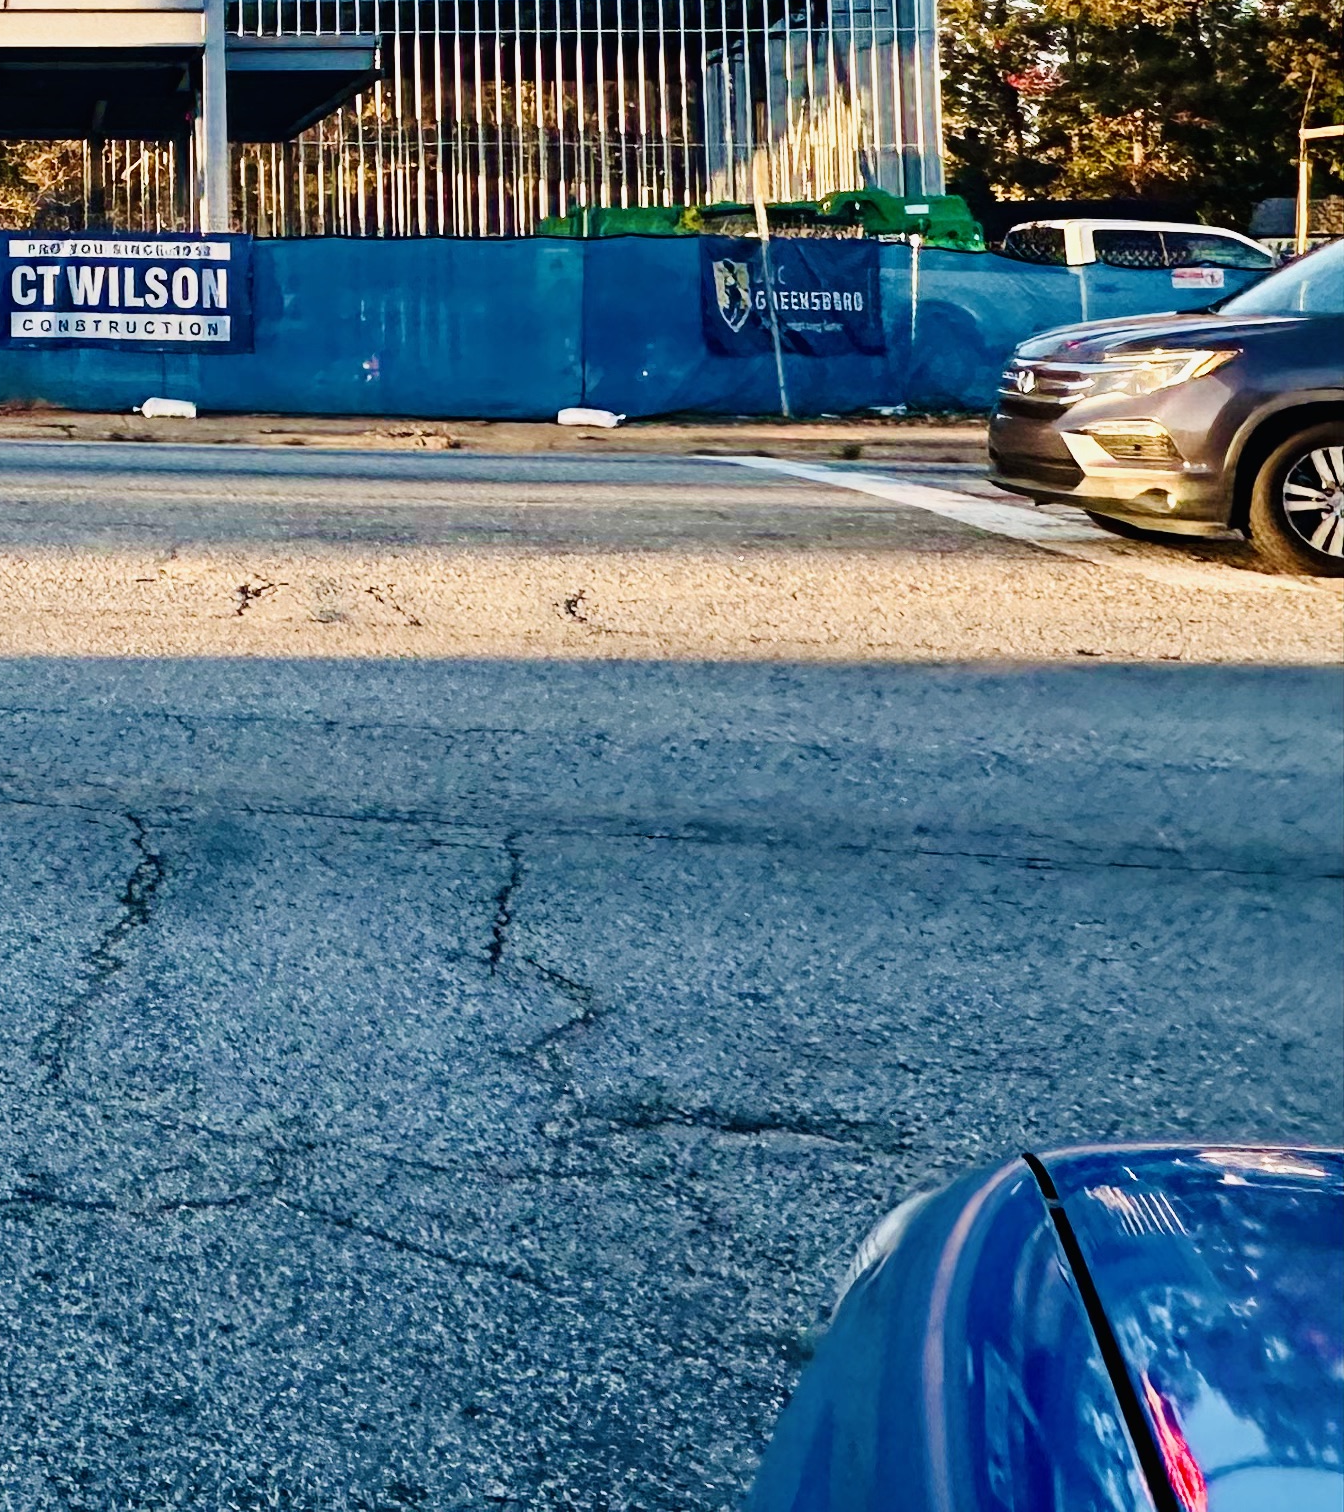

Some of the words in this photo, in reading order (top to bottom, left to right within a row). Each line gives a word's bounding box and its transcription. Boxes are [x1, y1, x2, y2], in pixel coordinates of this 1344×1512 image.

[69, 244, 103, 255] YOU
[12, 265, 60, 306] CT
[66, 266, 228, 309] WILSON
[22, 319, 219, 337] CONSTRUCTION
